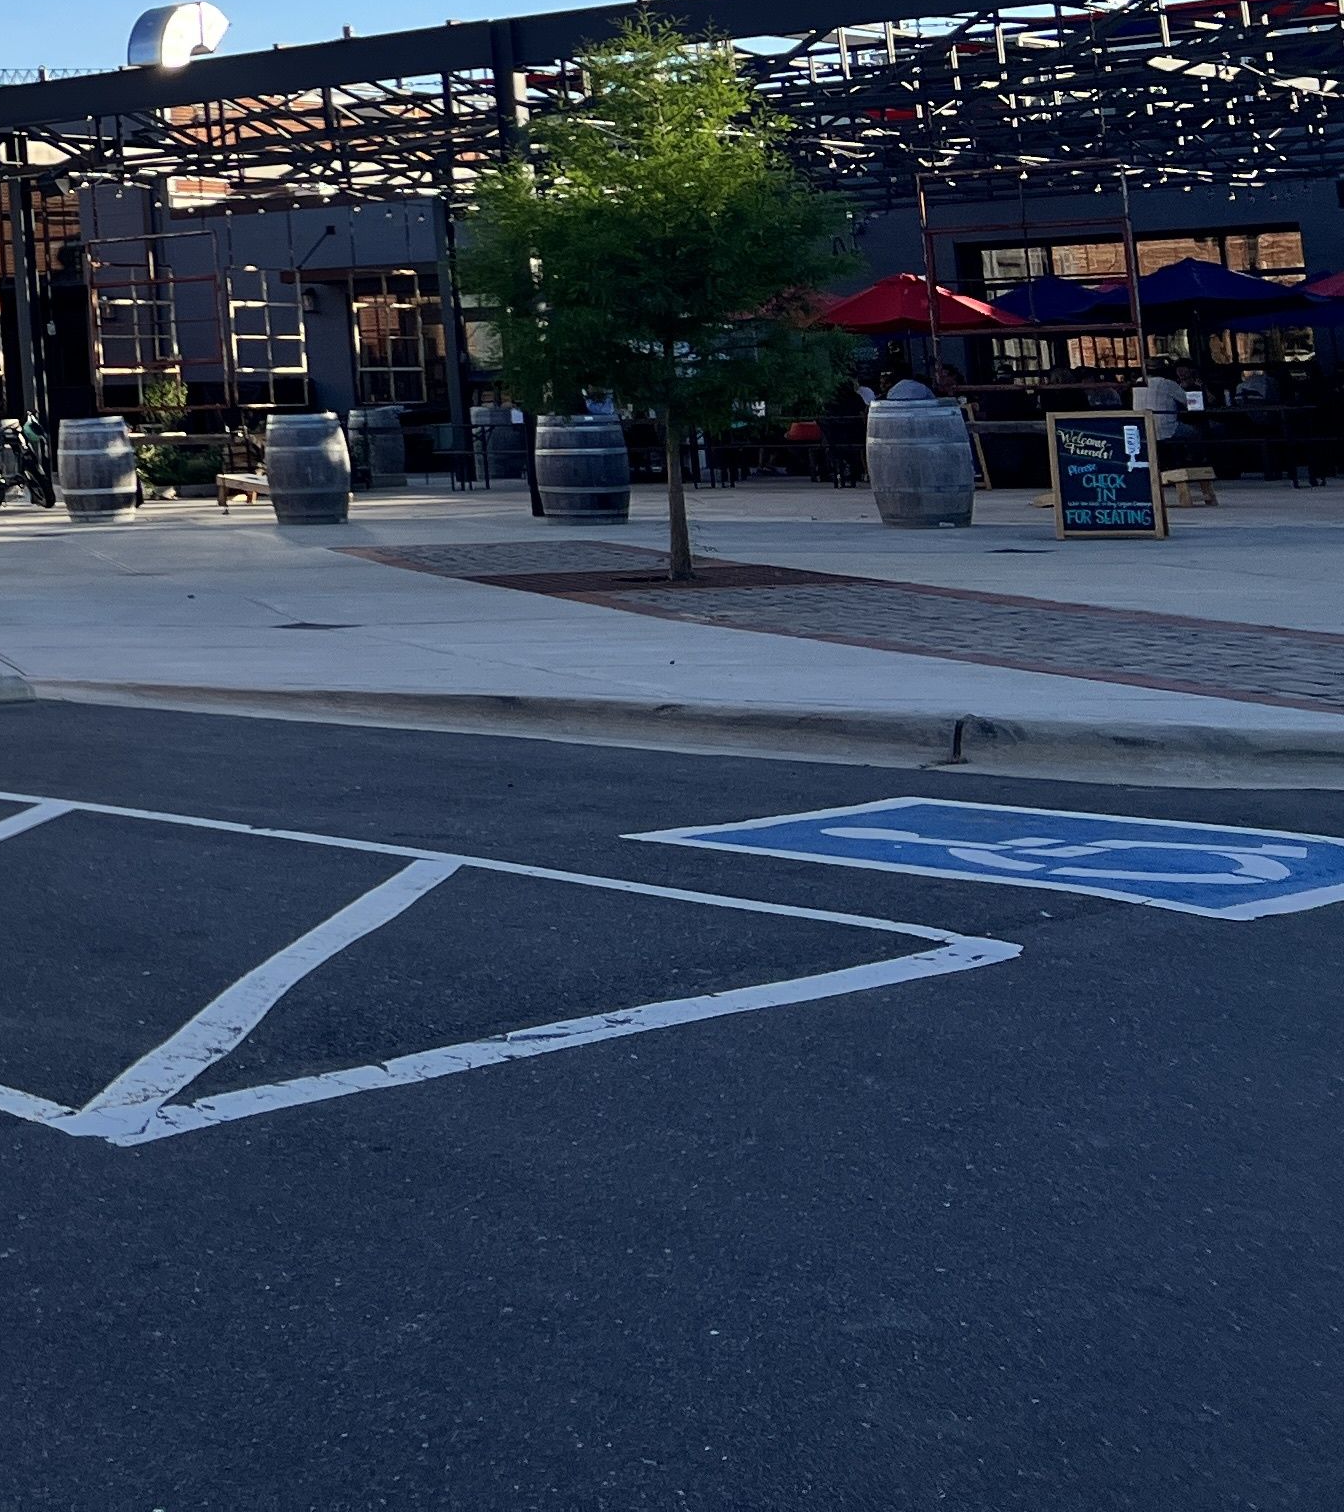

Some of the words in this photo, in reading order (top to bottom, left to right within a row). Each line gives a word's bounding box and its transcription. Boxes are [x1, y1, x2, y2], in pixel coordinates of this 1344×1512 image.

[1083, 474, 1126, 488] CHECK
[1097, 488, 1116, 502] IN
[1065, 509, 1092, 524] FOR
[1095, 509, 1152, 525] SEATING
